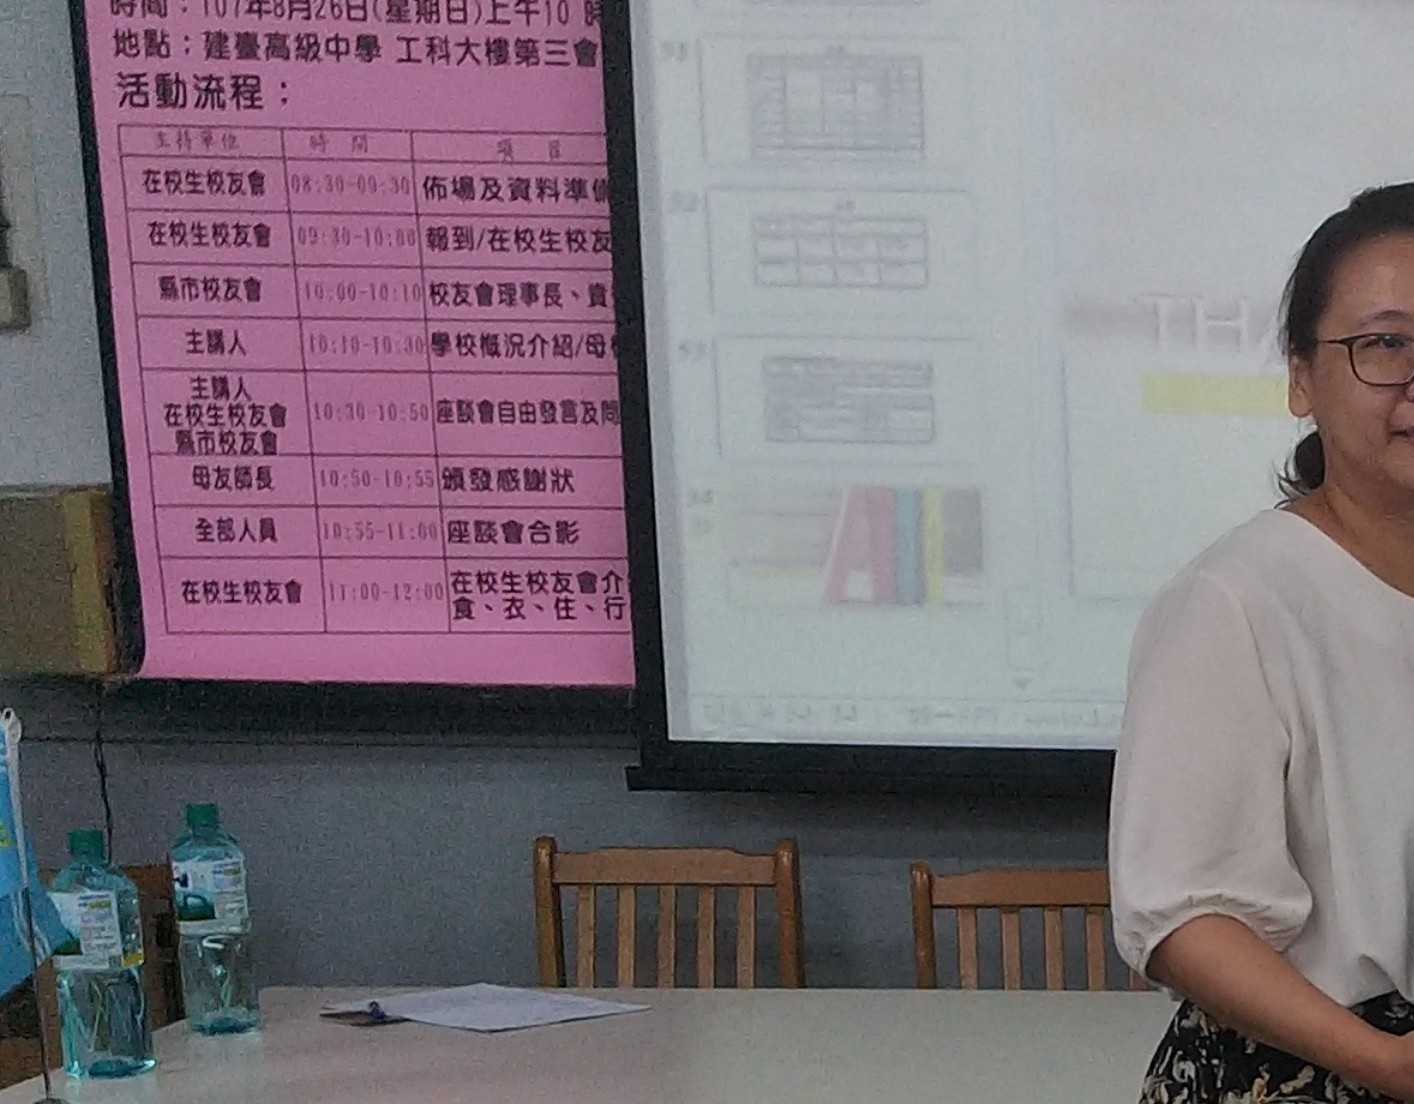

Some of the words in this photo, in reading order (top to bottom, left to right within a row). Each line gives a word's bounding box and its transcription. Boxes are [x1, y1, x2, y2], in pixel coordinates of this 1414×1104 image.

[142, 168, 266, 197] 在校生校友會
[148, 219, 272, 249] 在校生校友會
[163, 402, 288, 429] 在校生校友會
[195, 516, 279, 544] 全部人員
[447, 519, 580, 546] 座談會合影
[181, 578, 302, 606] 在校生校友會
